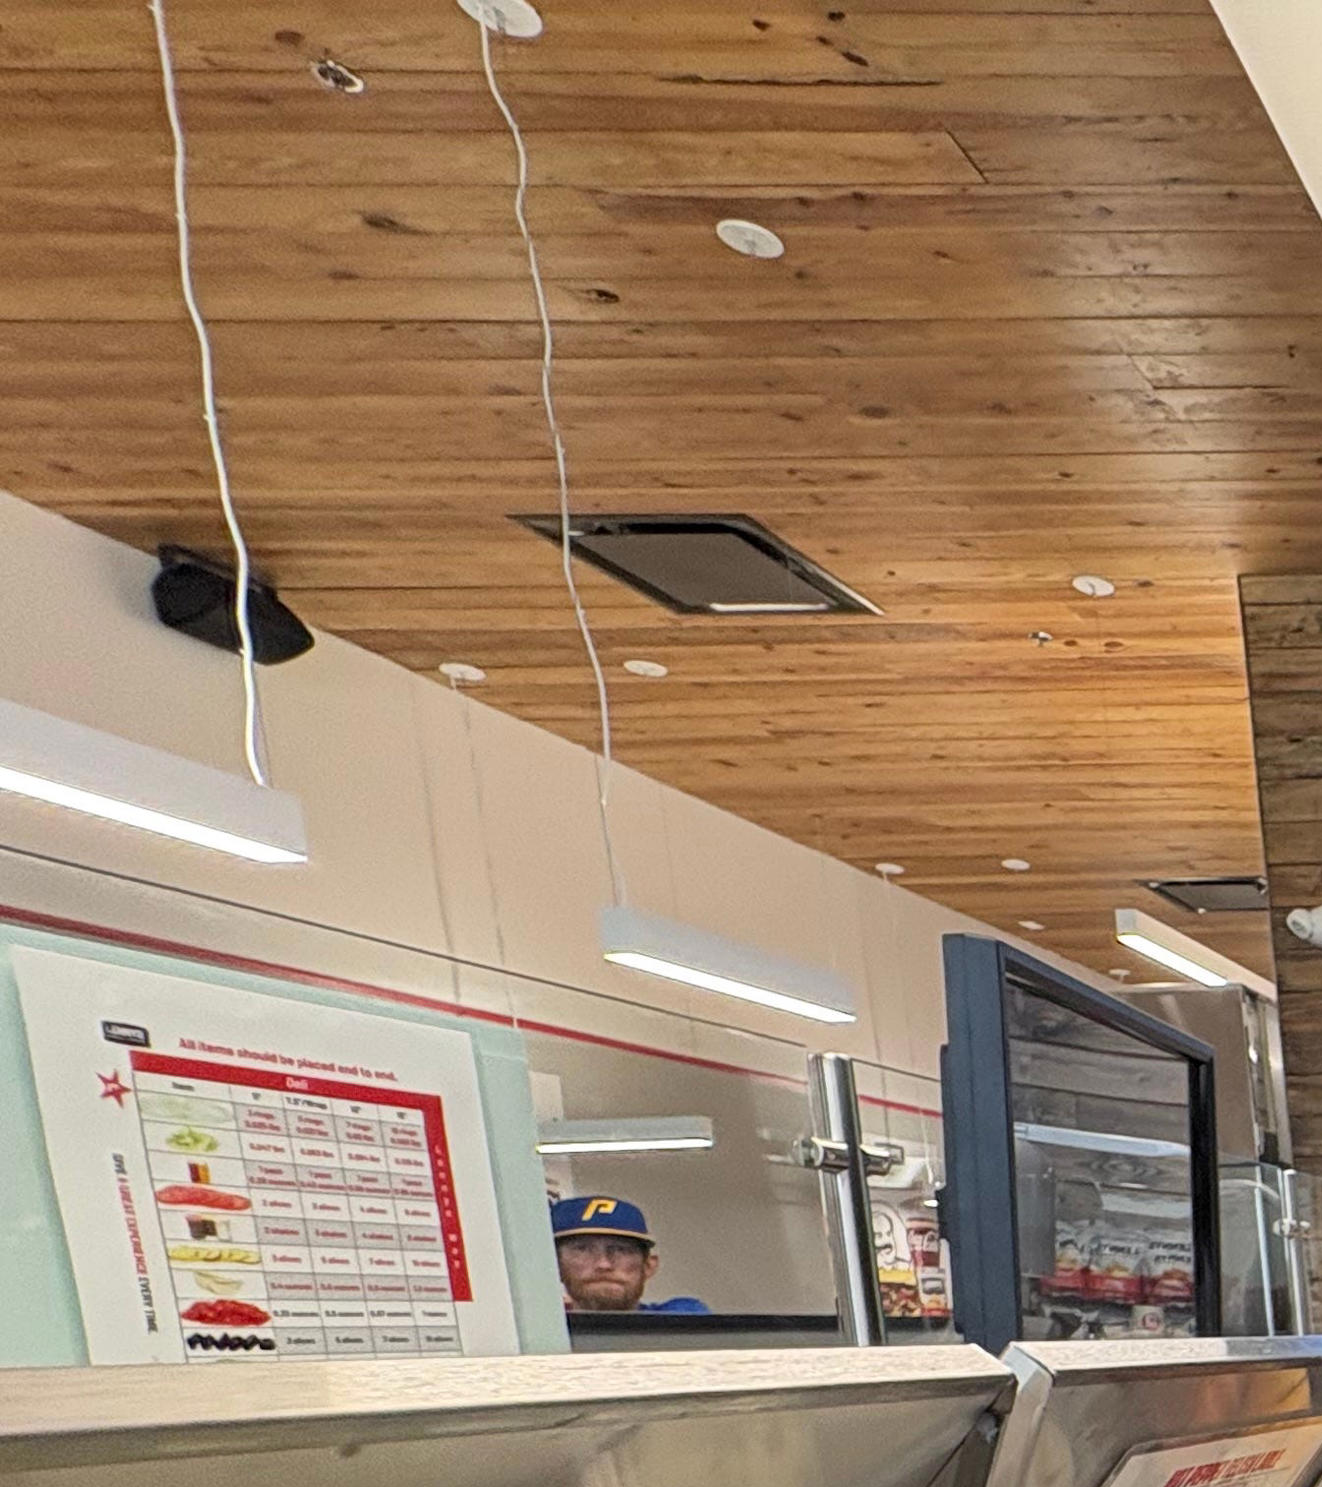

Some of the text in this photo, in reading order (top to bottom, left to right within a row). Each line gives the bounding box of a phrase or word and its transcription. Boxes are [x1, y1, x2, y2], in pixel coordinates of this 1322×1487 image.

[237, 1047, 277, 1063] should
[279, 1054, 295, 1066] be
[297, 1058, 336, 1073] placed
[360, 1067, 373, 1078] to
[582, 1198, 619, 1222] P
[125, 1217, 148, 1275] EXPERIENCE
[138, 1276, 154, 1309] EVERY
